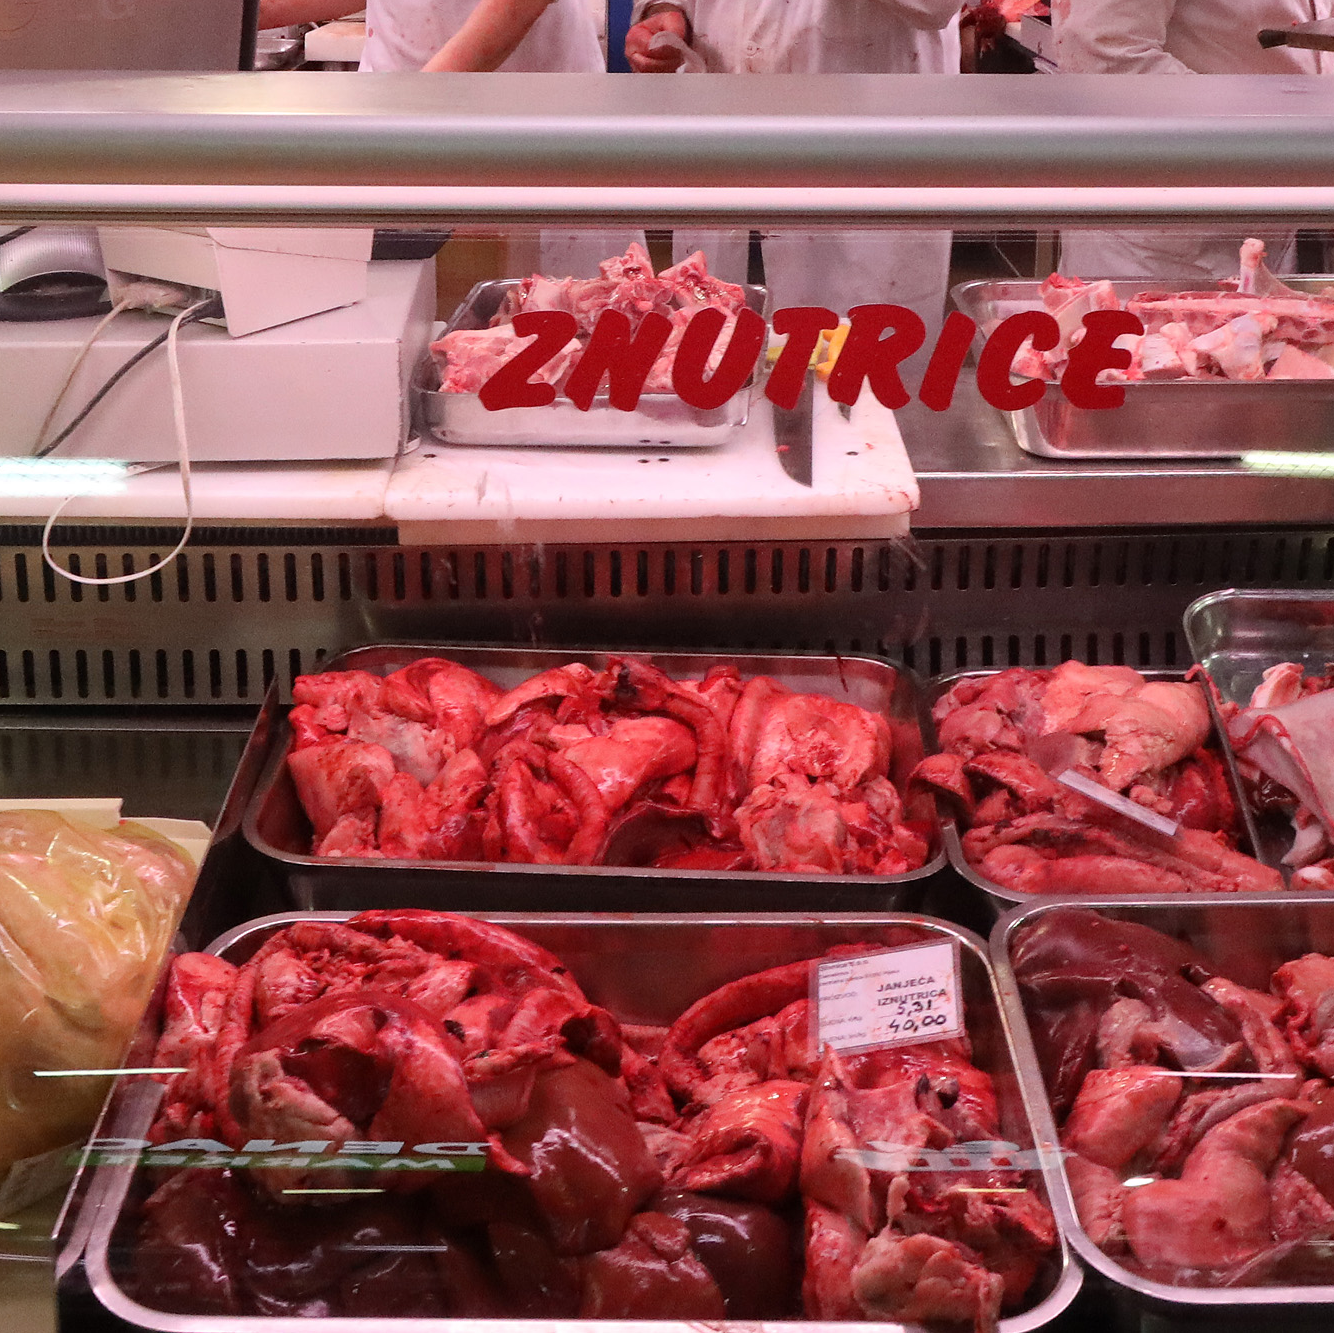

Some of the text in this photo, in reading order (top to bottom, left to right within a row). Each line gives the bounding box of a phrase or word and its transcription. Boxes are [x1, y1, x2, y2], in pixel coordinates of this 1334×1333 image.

[477, 303, 1147, 414] ZNUTRICE
[877, 987, 948, 1007] IZNUTRICA
[888, 1013, 948, 1034] 40,00
